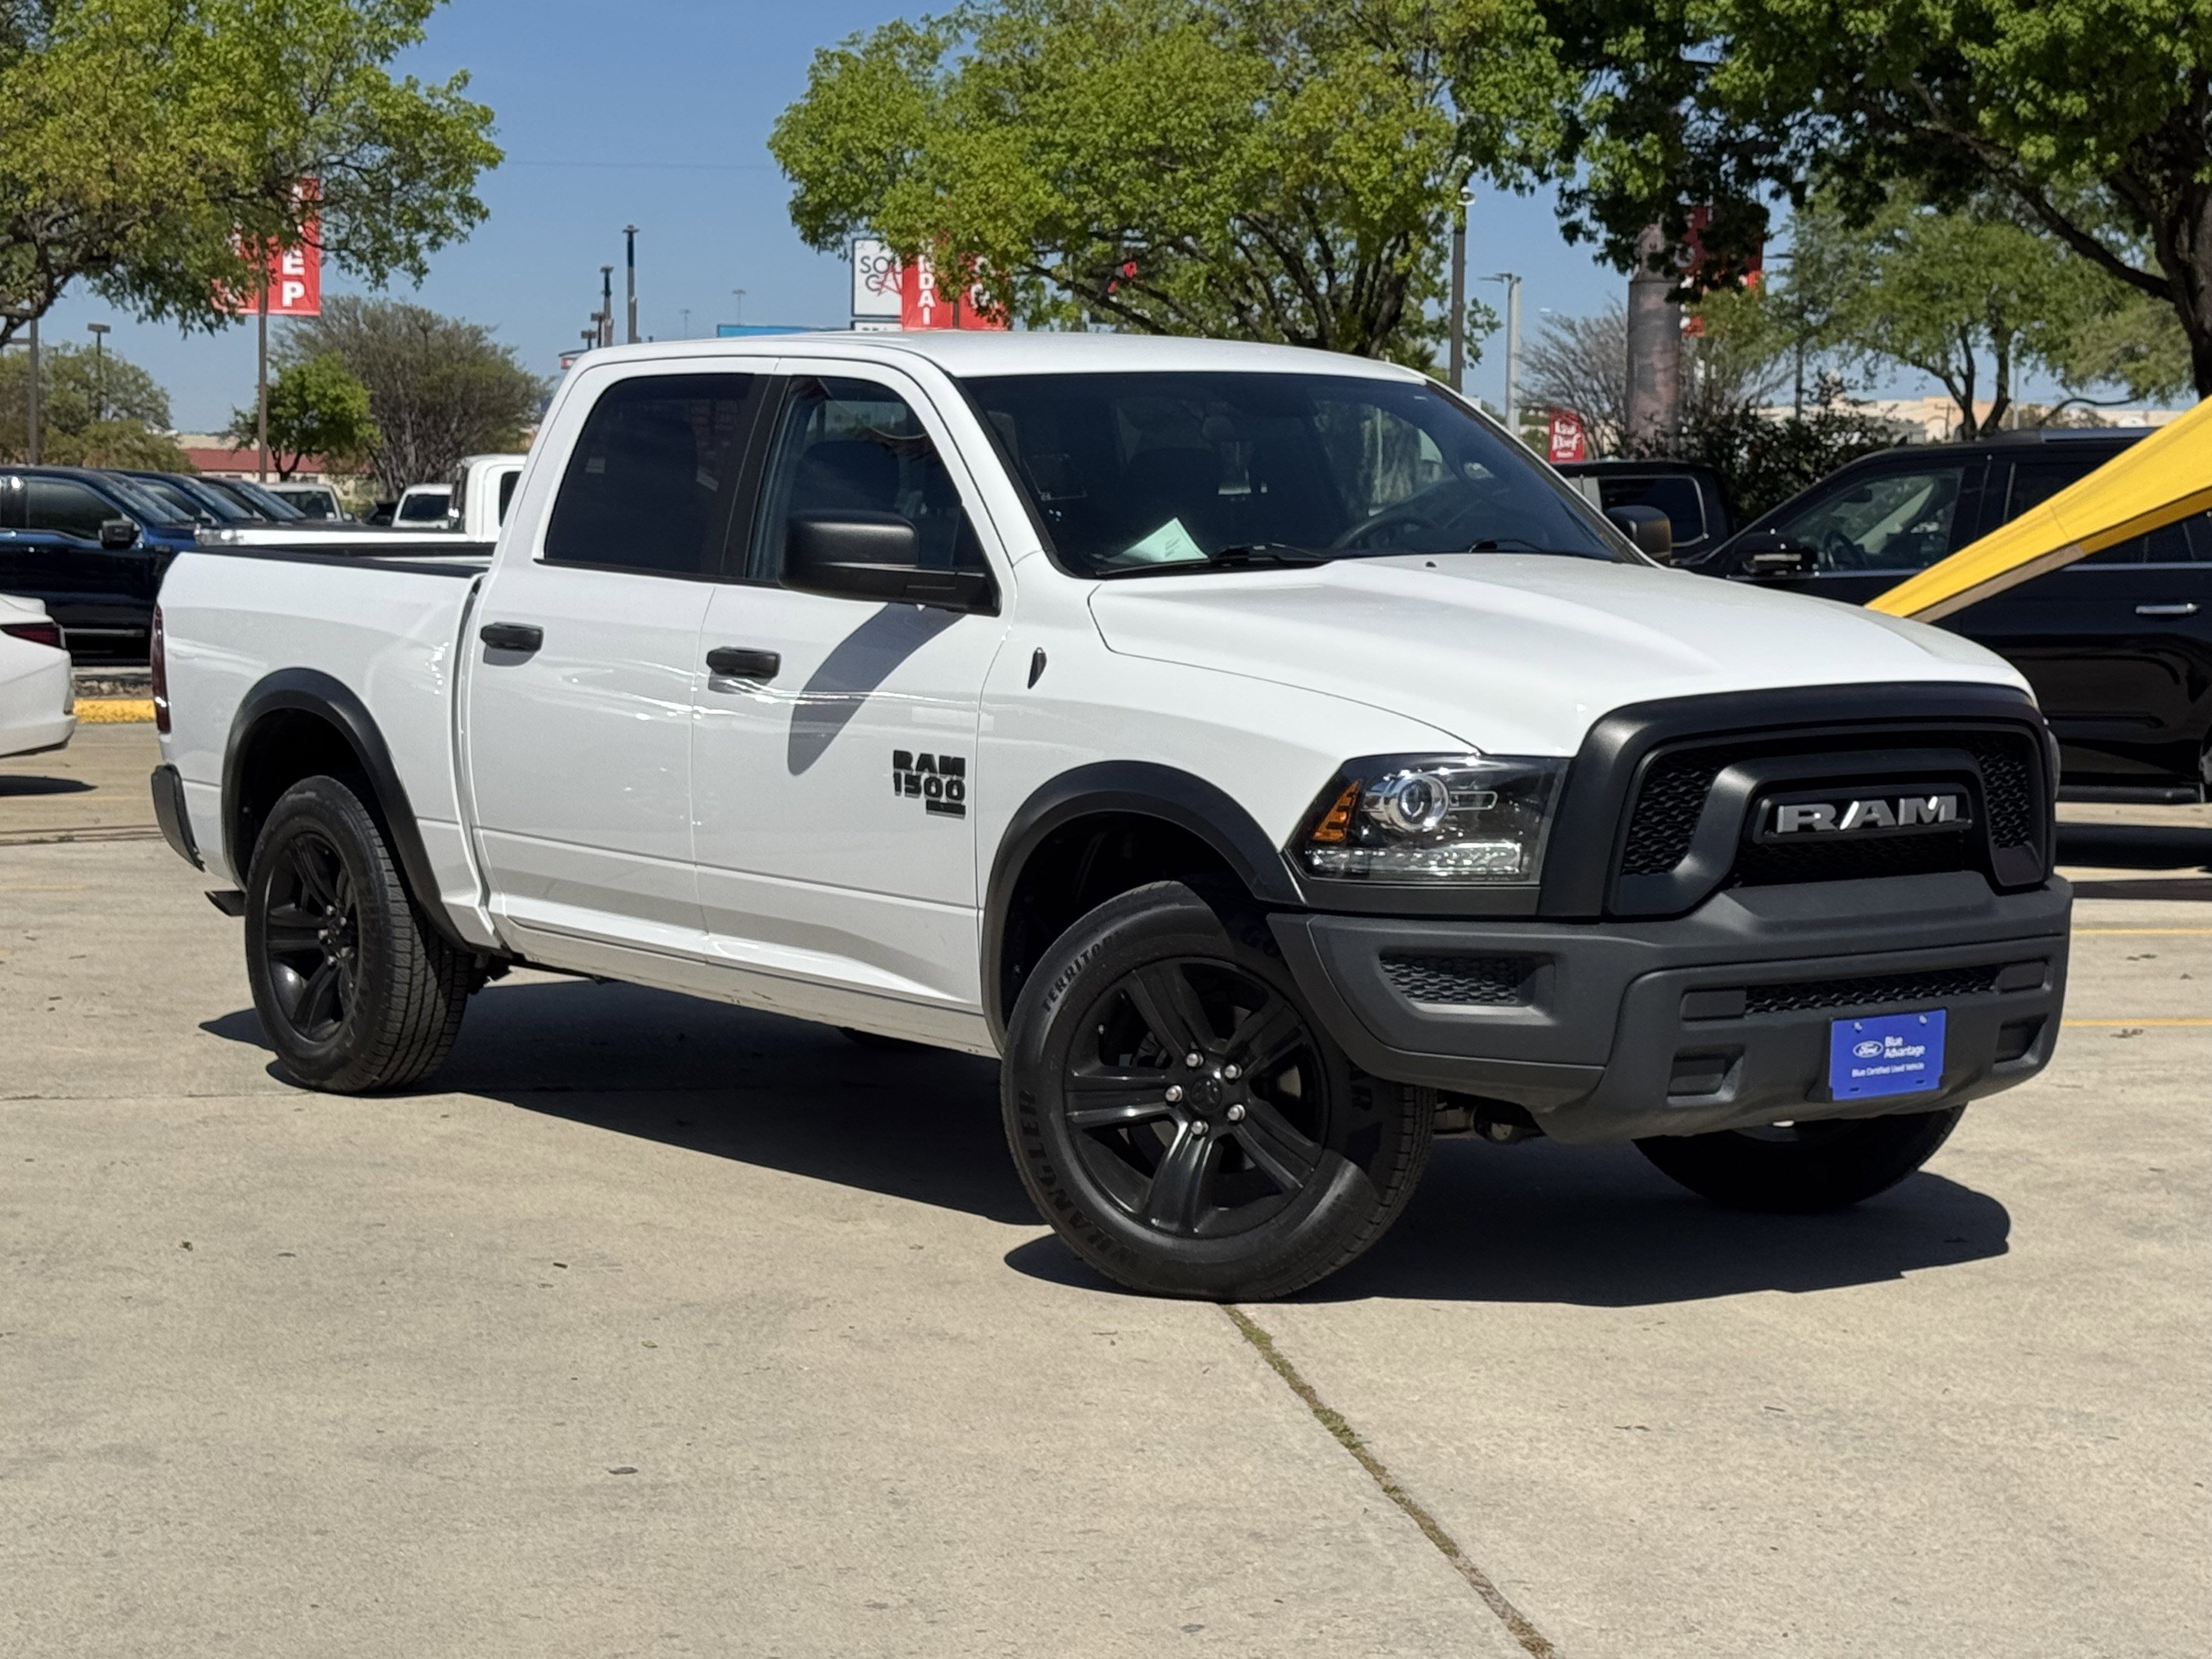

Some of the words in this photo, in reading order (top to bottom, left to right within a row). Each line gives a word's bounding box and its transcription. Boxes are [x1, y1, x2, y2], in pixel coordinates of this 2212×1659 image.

[893, 749, 966, 779] RAM
[894, 773, 966, 803] 1500
[1777, 795, 1958, 833] RAM
[1883, 1045, 1926, 1059] Advantage
[1884, 1036, 1904, 1047] Blue
